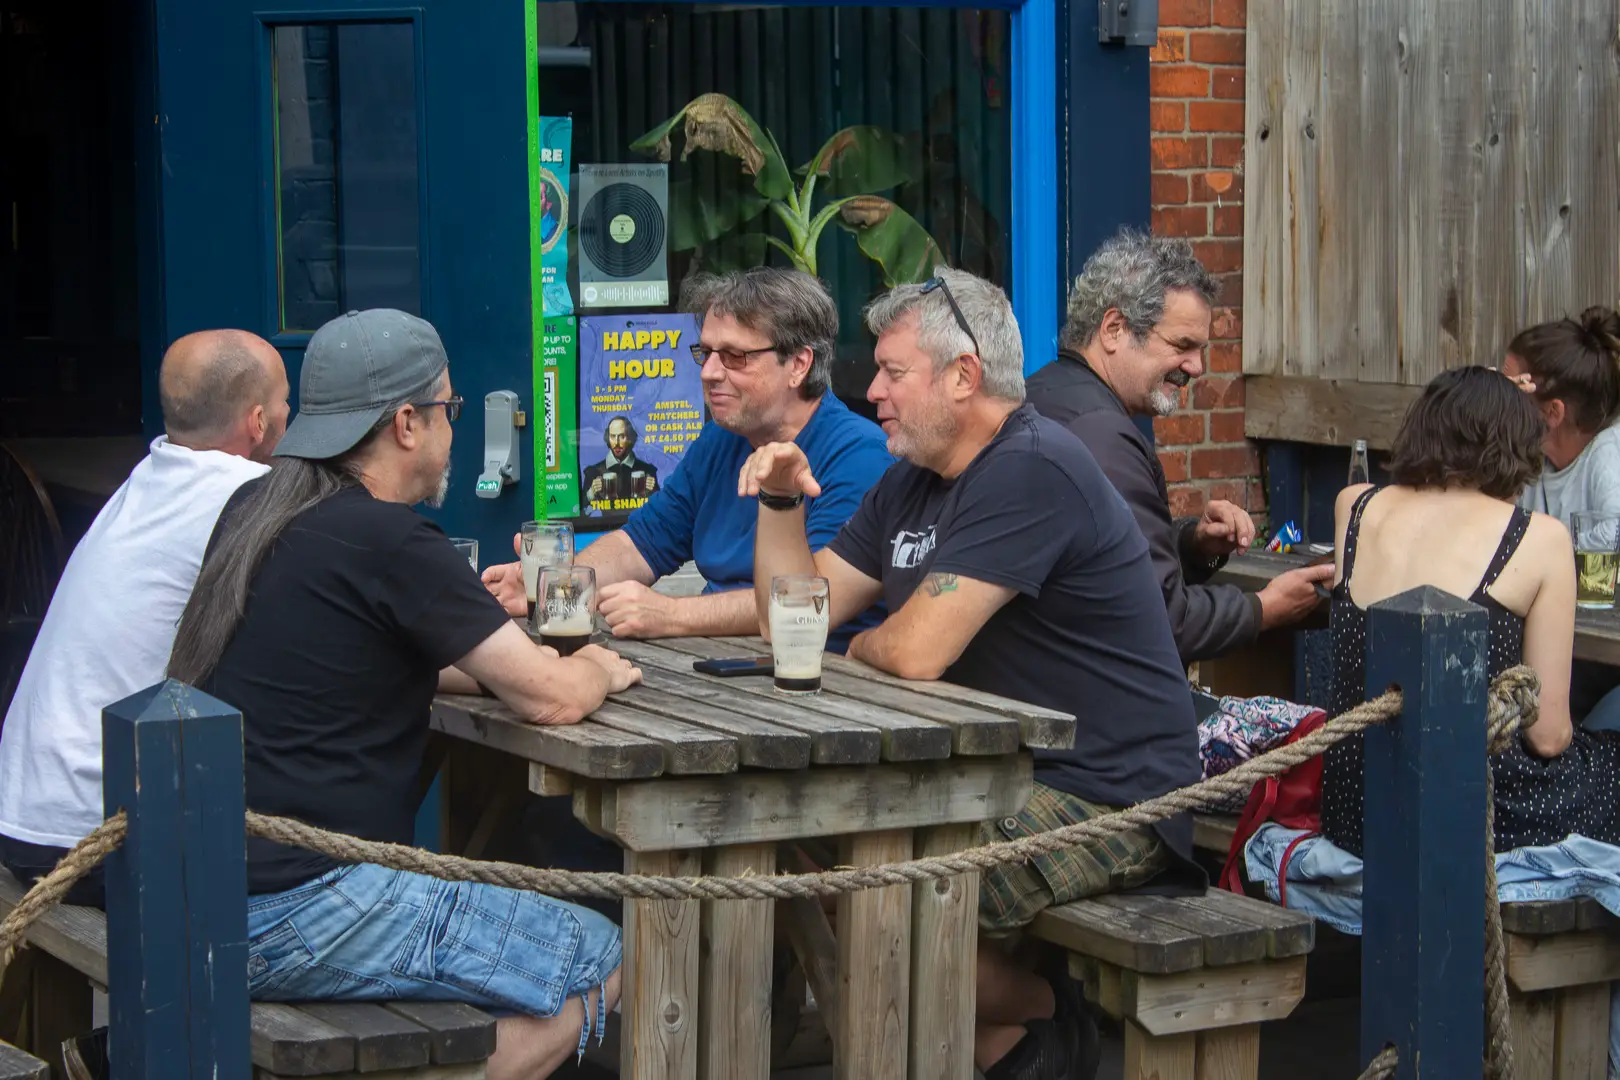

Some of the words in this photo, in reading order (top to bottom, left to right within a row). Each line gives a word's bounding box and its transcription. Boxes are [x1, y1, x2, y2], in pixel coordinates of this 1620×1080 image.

[540, 148, 563, 162] RE
[561, 335, 572, 344] TO
[603, 330, 681, 351] HAPPY
[609, 358, 676, 379] HOUR
[613, 384, 627, 393] PM
[591, 395, 626, 403] MONDAY
[591, 403, 633, 413] THURSDAY
[648, 411, 700, 421] THATCHERS
[645, 423, 658, 432] OR
[660, 422, 683, 432] CASK
[685, 421, 703, 431] ALE
[644, 435, 657, 444] AT
[663, 444, 684, 455] PINT
[590, 499, 611, 511] THE
